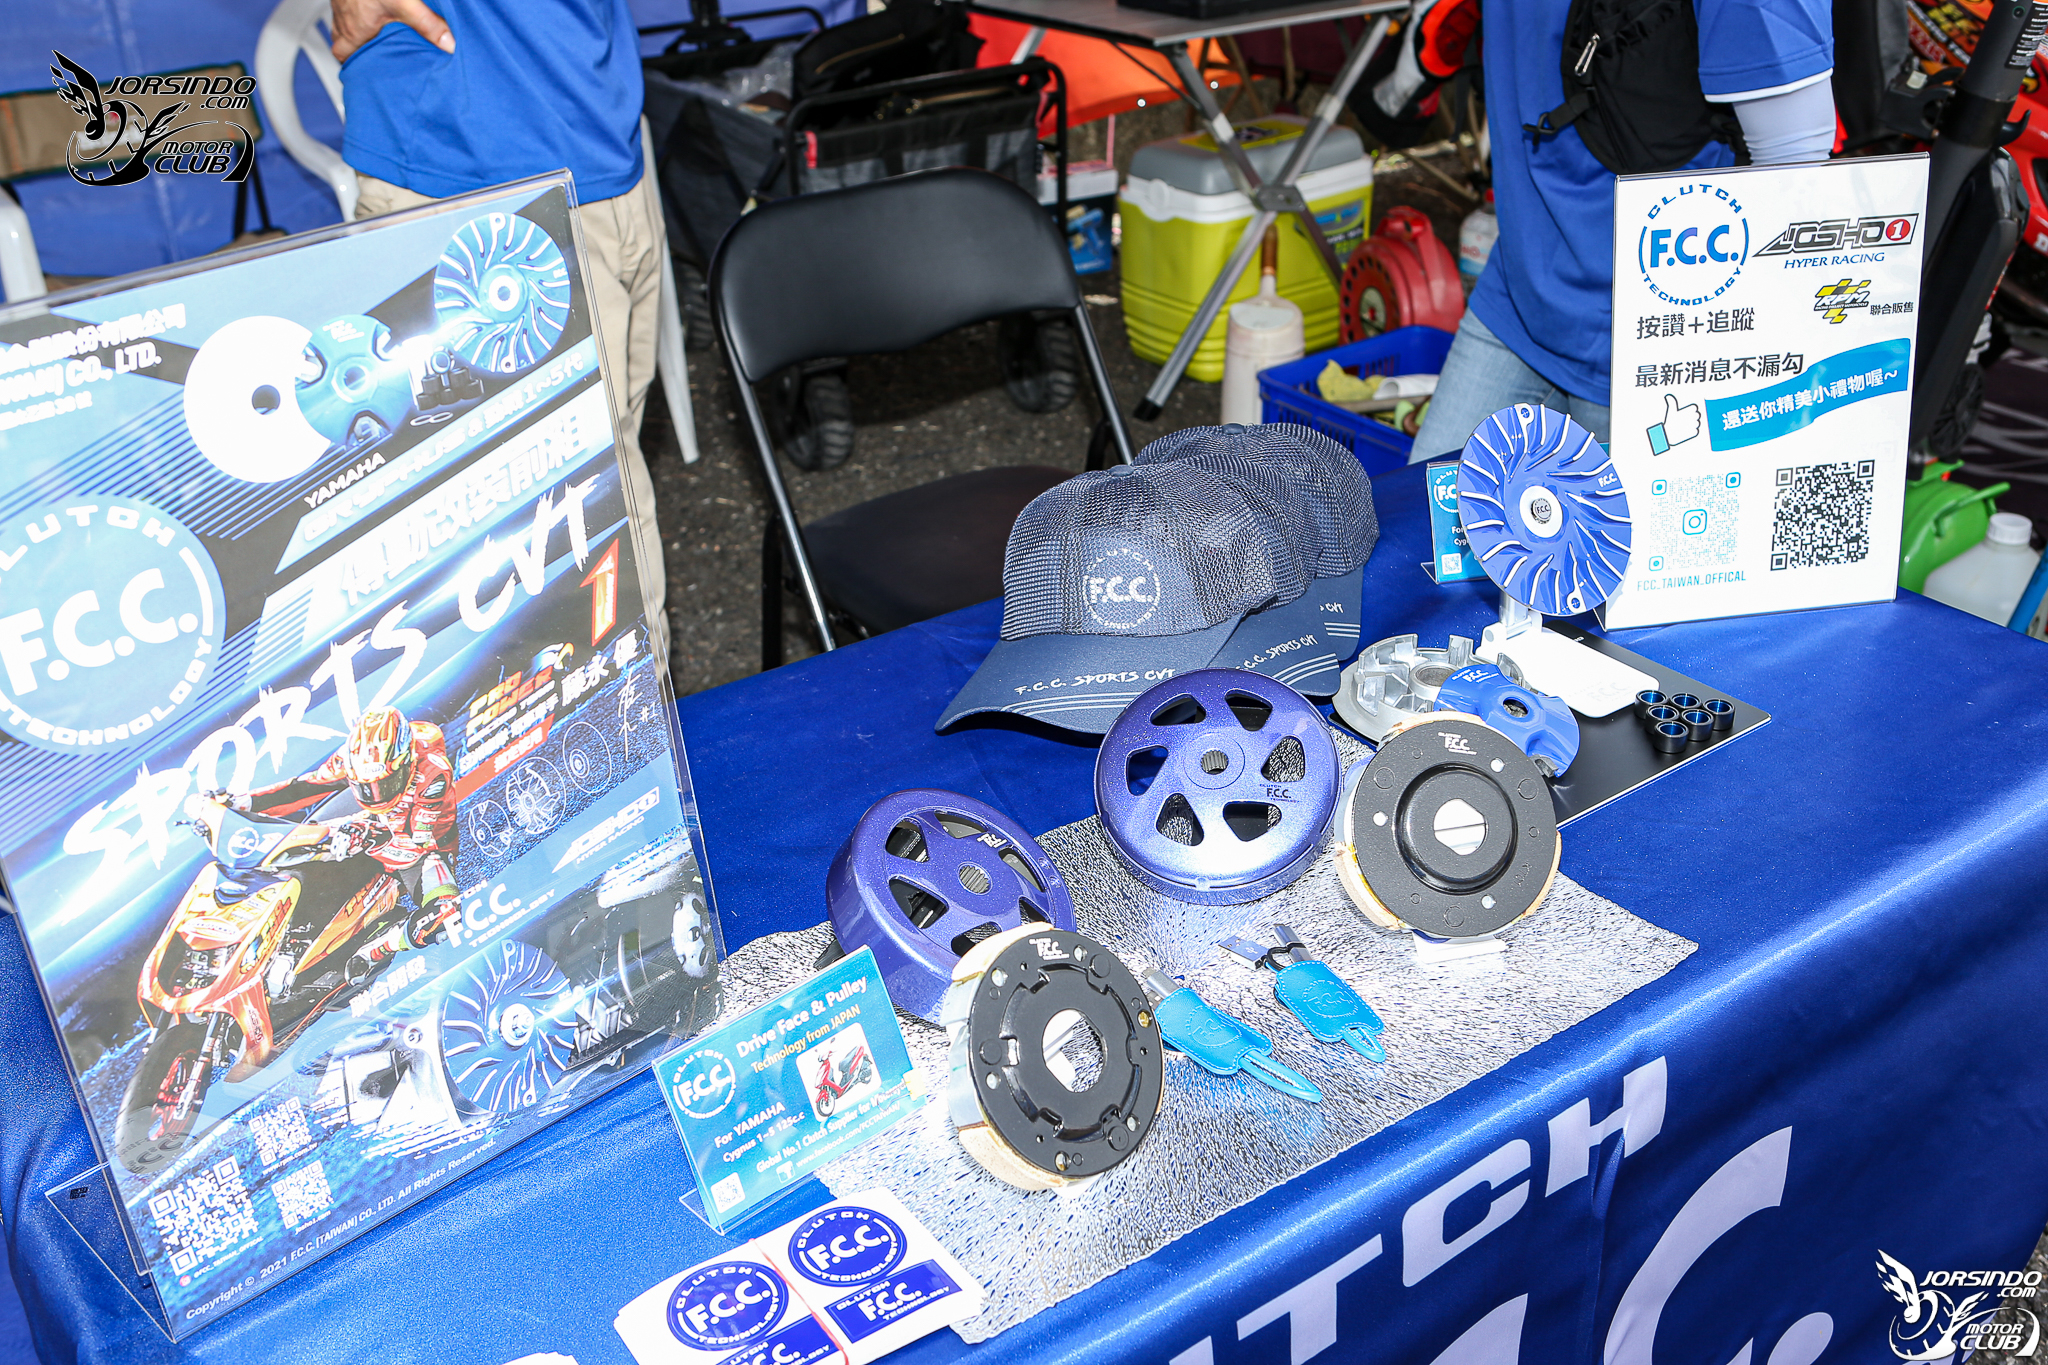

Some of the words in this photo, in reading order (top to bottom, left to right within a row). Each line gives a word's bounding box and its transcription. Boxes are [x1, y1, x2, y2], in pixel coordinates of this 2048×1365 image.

[1647, 184, 1743, 219] CLUTCH
[1650, 224, 1739, 268] F.C.C.
[1784, 256, 1830, 269] HYPER
[1831, 252, 1885, 265] RACING
[1642, 266, 1742, 306] TECHNOLOGY
[1816, 290, 1869, 306] RPM
[1870, 302, 1914, 316] 聯合販售
[115, 342, 162, 375] LTD.
[1635, 352, 1804, 388] 最新消息不漏勾
[467, 421, 483, 437] &
[304, 451, 386, 509] YAMAHA
[1597, 472, 1618, 488] F.C.C.
[0, 504, 176, 572] LUTCH
[1089, 575, 1154, 603] F.C.C.
[1325, 602, 1344, 613] CVT
[1236, 654, 1267, 669] .C.C.
[1265, 639, 1302, 659] SPORTS
[1300, 634, 1318, 646] CVT
[60, 600, 428, 895] SPORTS
[459, 473, 600, 633] CVT
[466, 665, 553, 736] POWER
[469, 671, 522, 718] PRO
[1014, 678, 1067, 695] F.C.C.
[1071, 671, 1139, 687] SPORTS
[1144, 668, 1176, 680] CVT
[1267, 788, 1292, 799] F.C.C.
[442, 884, 521, 949] F.C.C.
[469, 889, 556, 948] TECHNOLOGY
[736, 1027, 777, 1058] Drive
[777, 1009, 810, 1035] Face
[811, 1000, 827, 1016] &
[825, 976, 868, 1008] Pulley
[750, 1039, 807, 1074] Technology
[806, 1022, 831, 1044] from
[830, 1004, 861, 1032] JAPAN
[677, 1064, 732, 1106] F.C.C.
[714, 1132, 734, 1148] For
[733, 1101, 786, 1136] YAMAHA
[756, 1154, 782, 1173] Global
[782, 1141, 802, 1158] No.1
[802, 1128, 827, 1146] Clutch
[826, 1112, 858, 1133] Supplier
[857, 1102, 870, 1116] for
[722, 1136, 757, 1163] Cygnus
[185, 1278, 244, 1320] Copyright
[260, 1255, 288, 1280] 2021
[376, 1196, 397, 1213] LTD.
[398, 1184, 413, 1200] All
[413, 1168, 447, 1194] Rights
[447, 1138, 497, 1170] Reserved.
[798, 1210, 870, 1249] CLUTCH
[807, 1224, 890, 1270] F.C.C.
[819, 1240, 898, 1282] TECHNOLOGY
[676, 1266, 753, 1309] CLUTCH
[685, 1280, 771, 1332] F.C.C.
[836, 1280, 891, 1311] CLUTCH
[858, 1282, 922, 1322] F.C.C.
[882, 1285, 950, 1321] TECHNOLOGY
[697, 1295, 780, 1345] TECHNOLOGY
